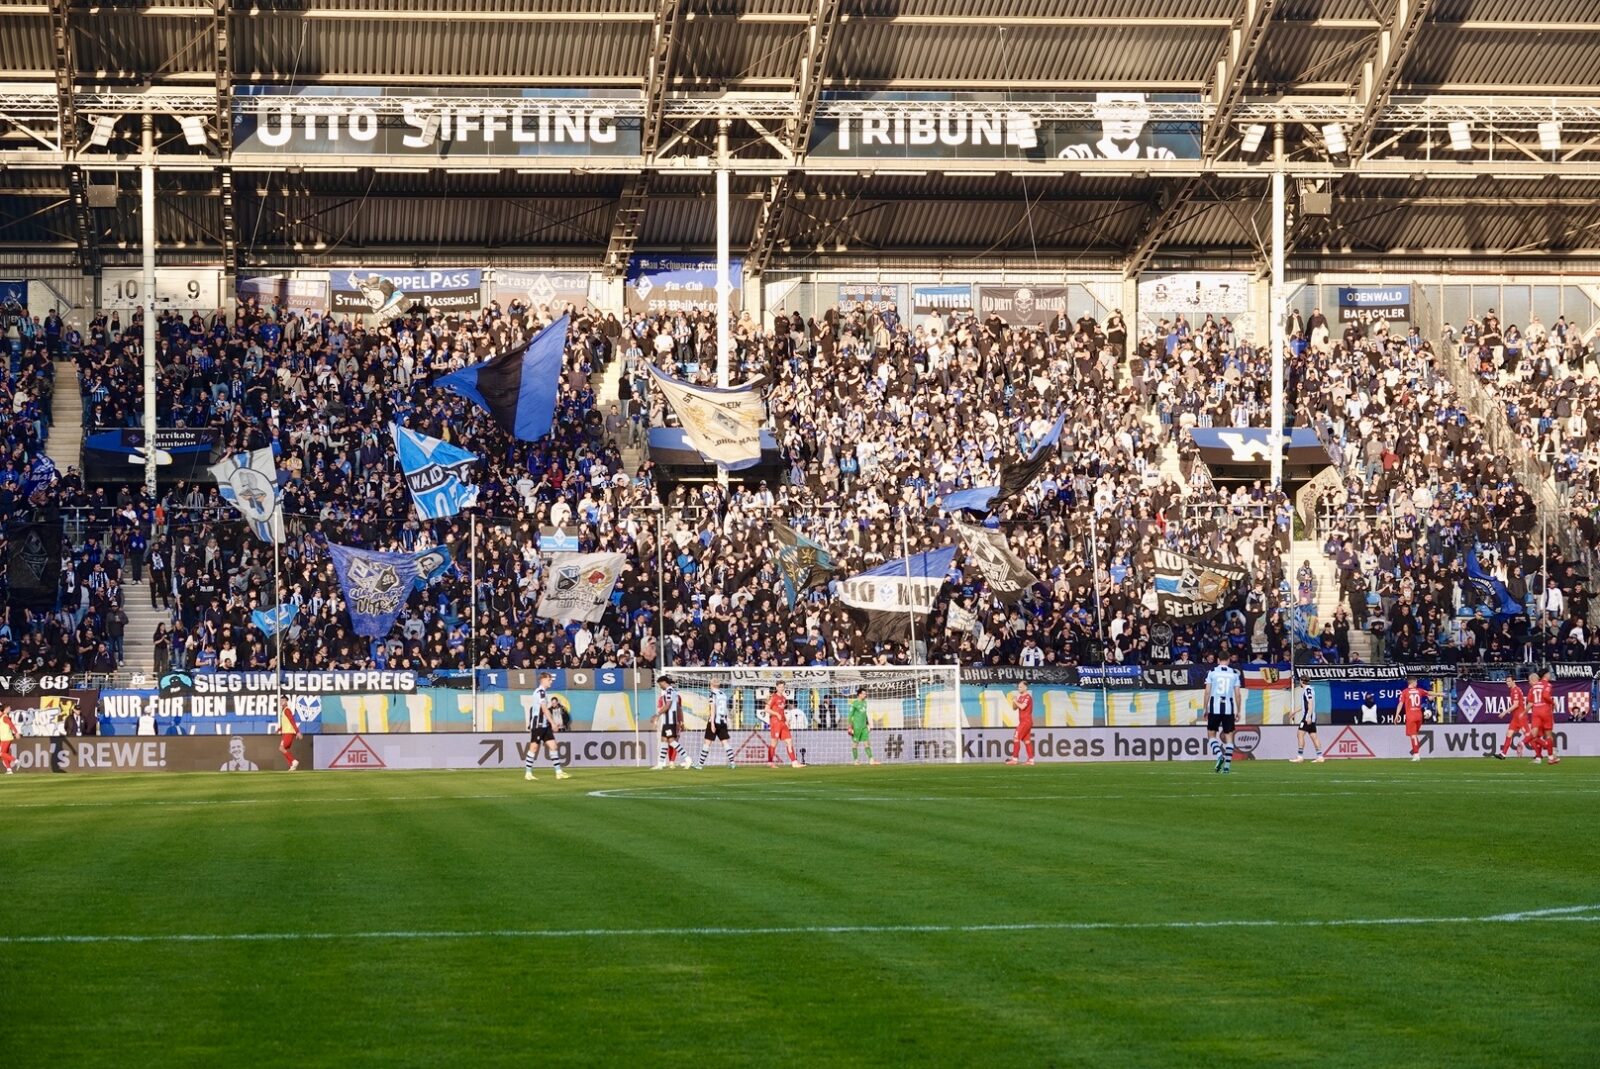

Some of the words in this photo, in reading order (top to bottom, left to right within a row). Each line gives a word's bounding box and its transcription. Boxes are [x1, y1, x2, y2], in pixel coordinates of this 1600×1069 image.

[113, 280, 138, 299] 10
[187, 280, 201, 299] 9
[1346, 291, 1403, 302] ODENWALD
[424, 292, 478, 306] RASSISMUS!
[994, 298, 1013, 311] DIRTY
[1151, 645, 1171, 660] KSA
[1347, 667, 1375, 678] SECHS
[1377, 667, 1398, 677] ACHT
[40, 675, 69, 690] 68
[194, 673, 242, 692] SIEG
[246, 673, 278, 691] UM
[281, 672, 350, 692] JEDEN
[353, 670, 415, 690] PREIS
[1217, 677, 1230, 694] 31
[1344, 691, 1367, 700] HEY
[1409, 693, 1420, 707] 10
[1532, 688, 1543, 704] 17
[104, 696, 142, 718] NUR
[191, 695, 227, 717] DEN
[78, 742, 167, 767] REWE!
